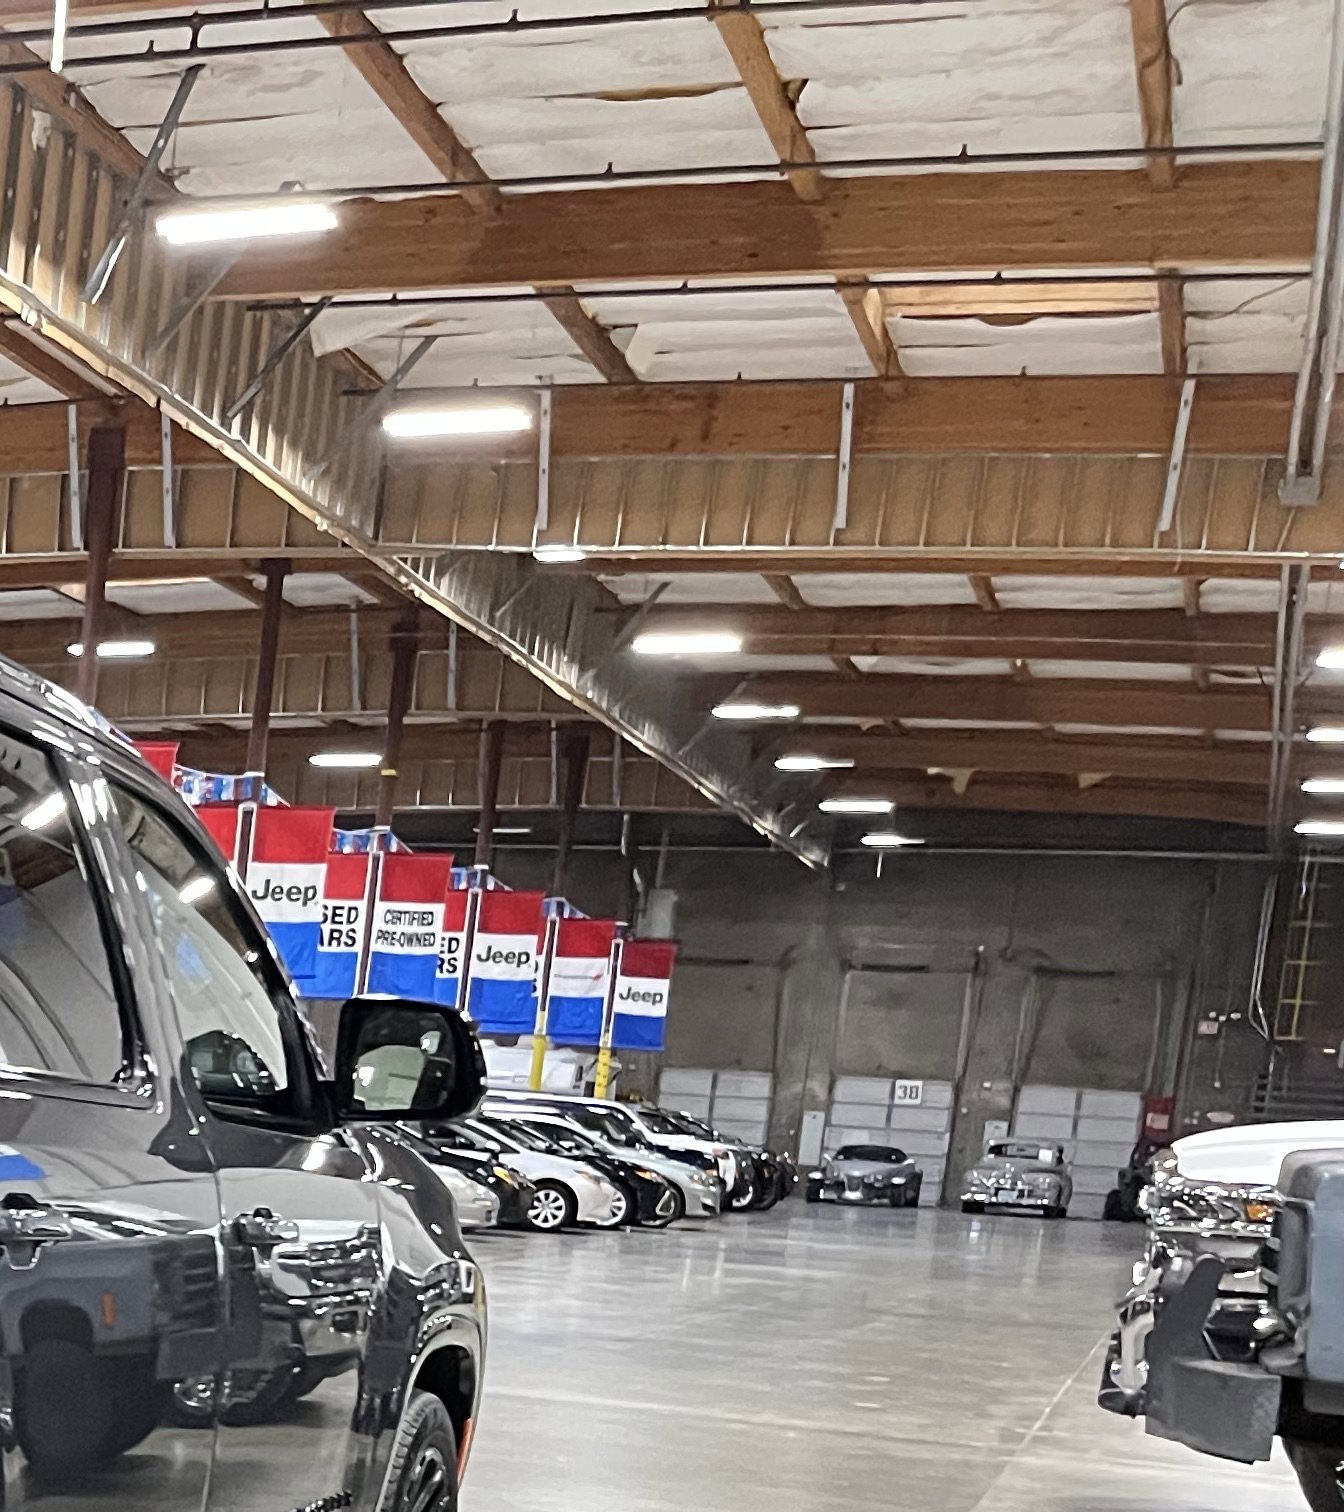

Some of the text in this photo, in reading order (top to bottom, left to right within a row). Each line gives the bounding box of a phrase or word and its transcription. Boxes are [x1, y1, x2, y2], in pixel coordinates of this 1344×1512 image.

[251, 879, 317, 907] Jeep
[384, 909, 434, 926] CERTIFIED
[375, 929, 436, 948] PRE-OWNED
[476, 945, 531, 968] Jeep
[618, 986, 664, 1006] Jeep
